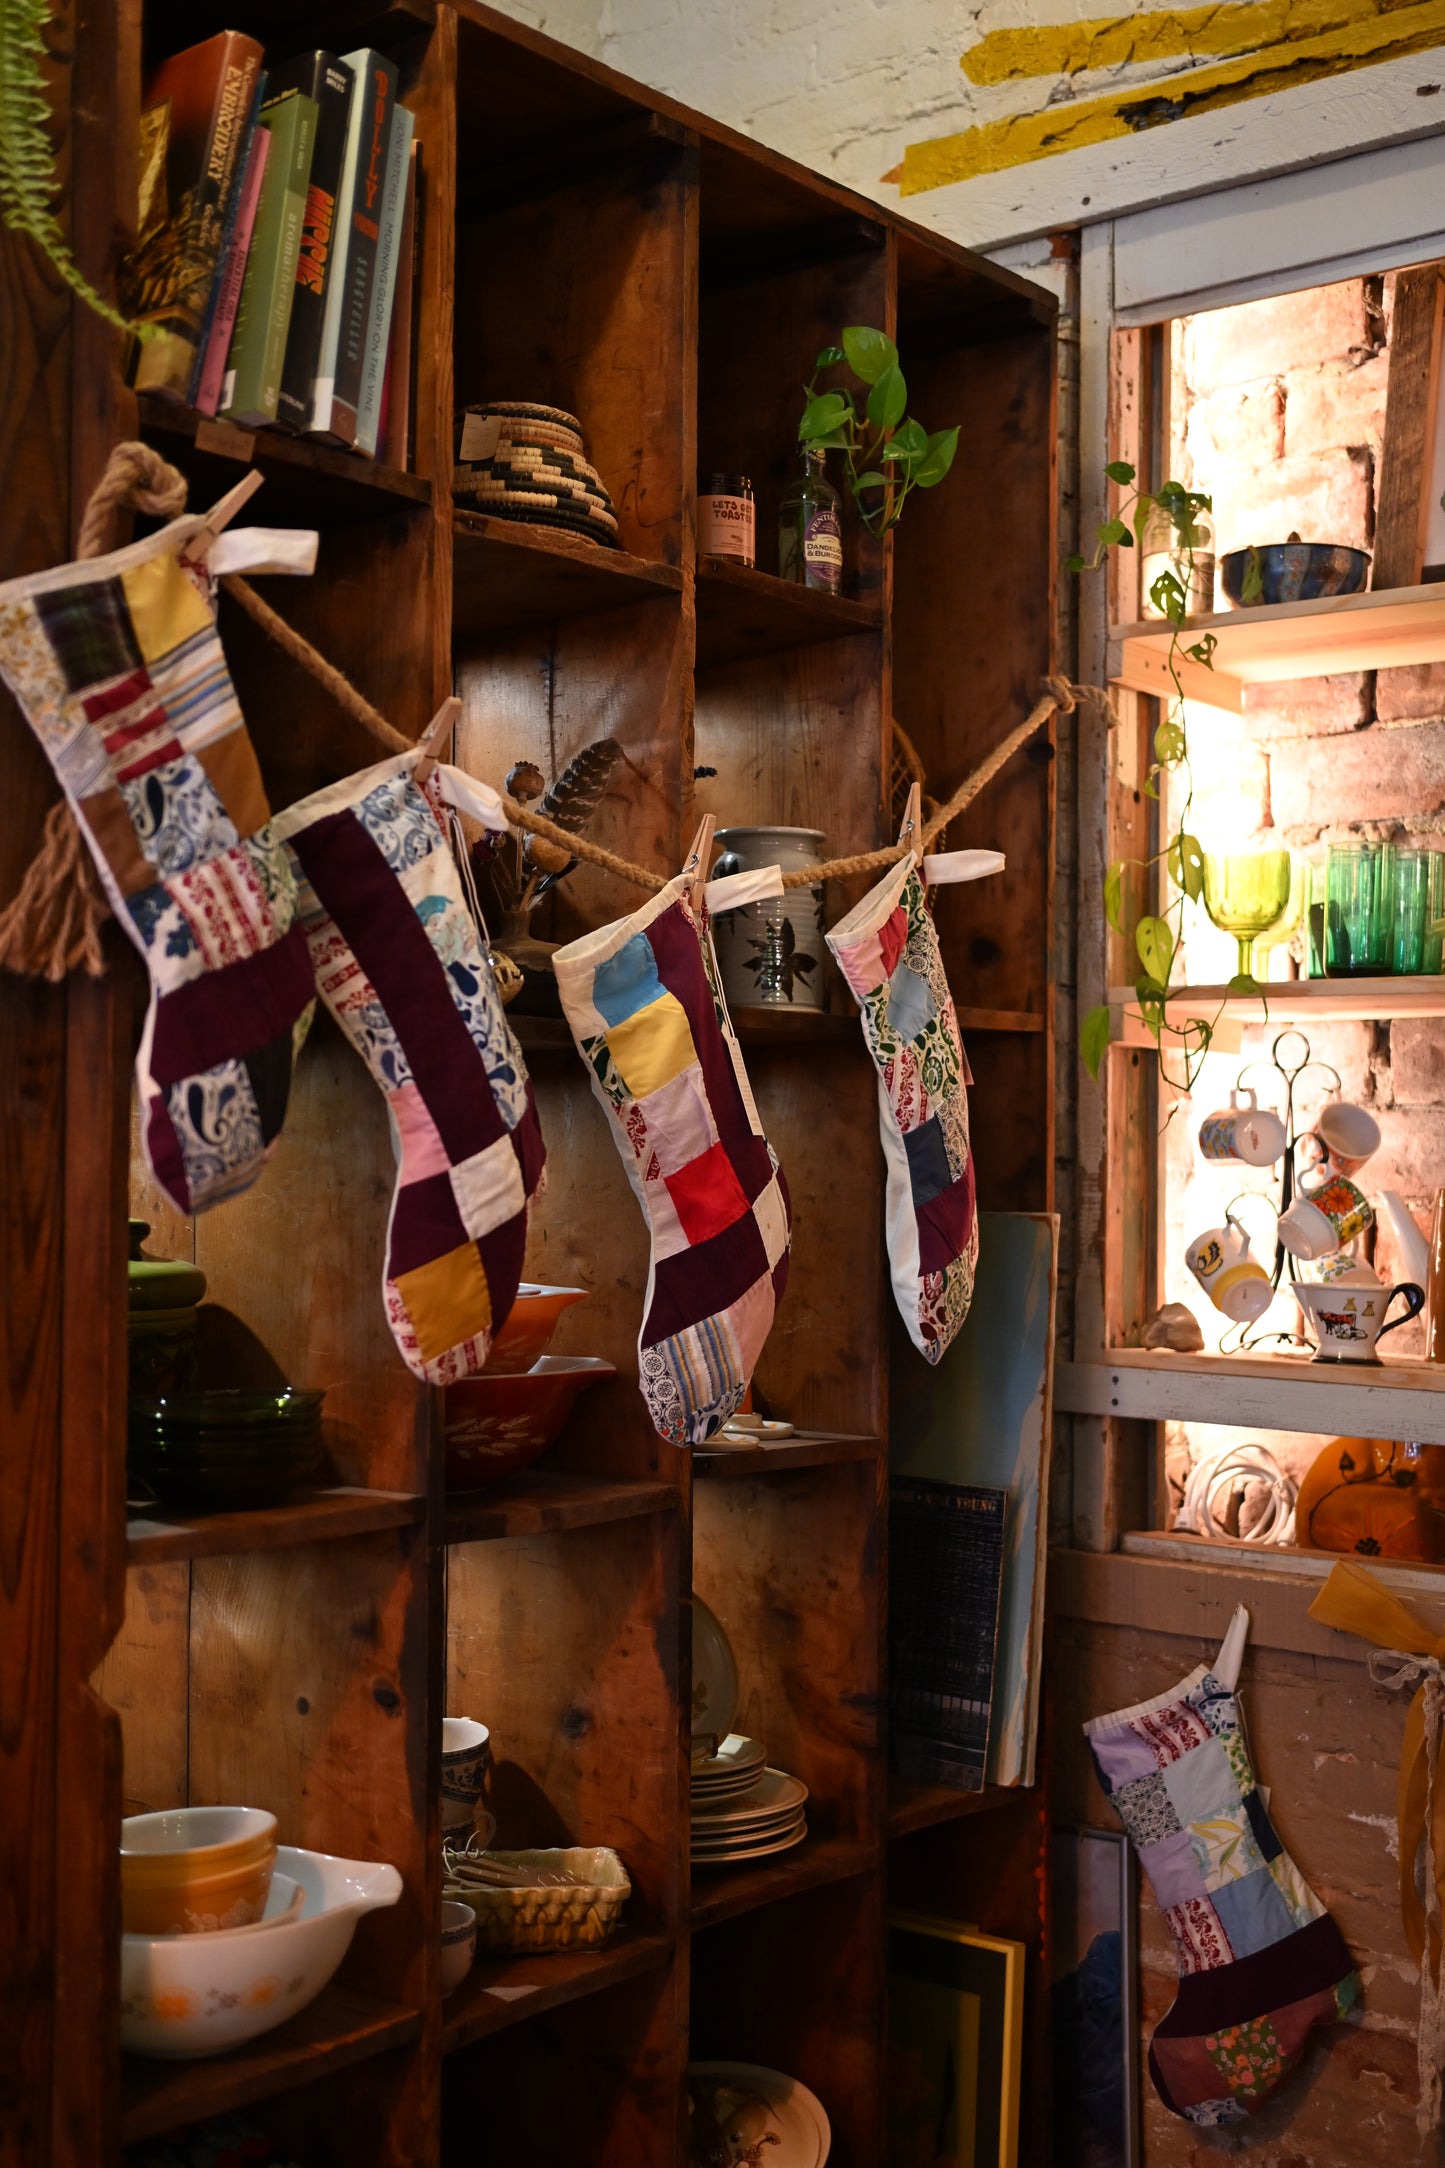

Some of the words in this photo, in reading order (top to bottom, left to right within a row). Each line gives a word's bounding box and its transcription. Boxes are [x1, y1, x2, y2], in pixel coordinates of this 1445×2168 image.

[207, 65, 242, 178] EMBROIDERY
[366, 70, 389, 209] DOLLY
[395, 121, 406, 150] JONI
[387, 151, 404, 213] MITCHELL
[297, 183, 335, 296] HIPPIE
[380, 221, 393, 284] MORNING
[274, 212, 297, 329] aromatherapy
[347, 256, 368, 360] SONGTELLER
[373, 286, 386, 329] GLORY
[371, 331, 381, 353] ON
[367, 355, 378, 380] THE
[363, 383, 376, 416] VINE
[712, 501, 738, 510] LETS
[815, 551, 842, 561] BURDOC
[956, 1497, 998, 1512] YOUNG
